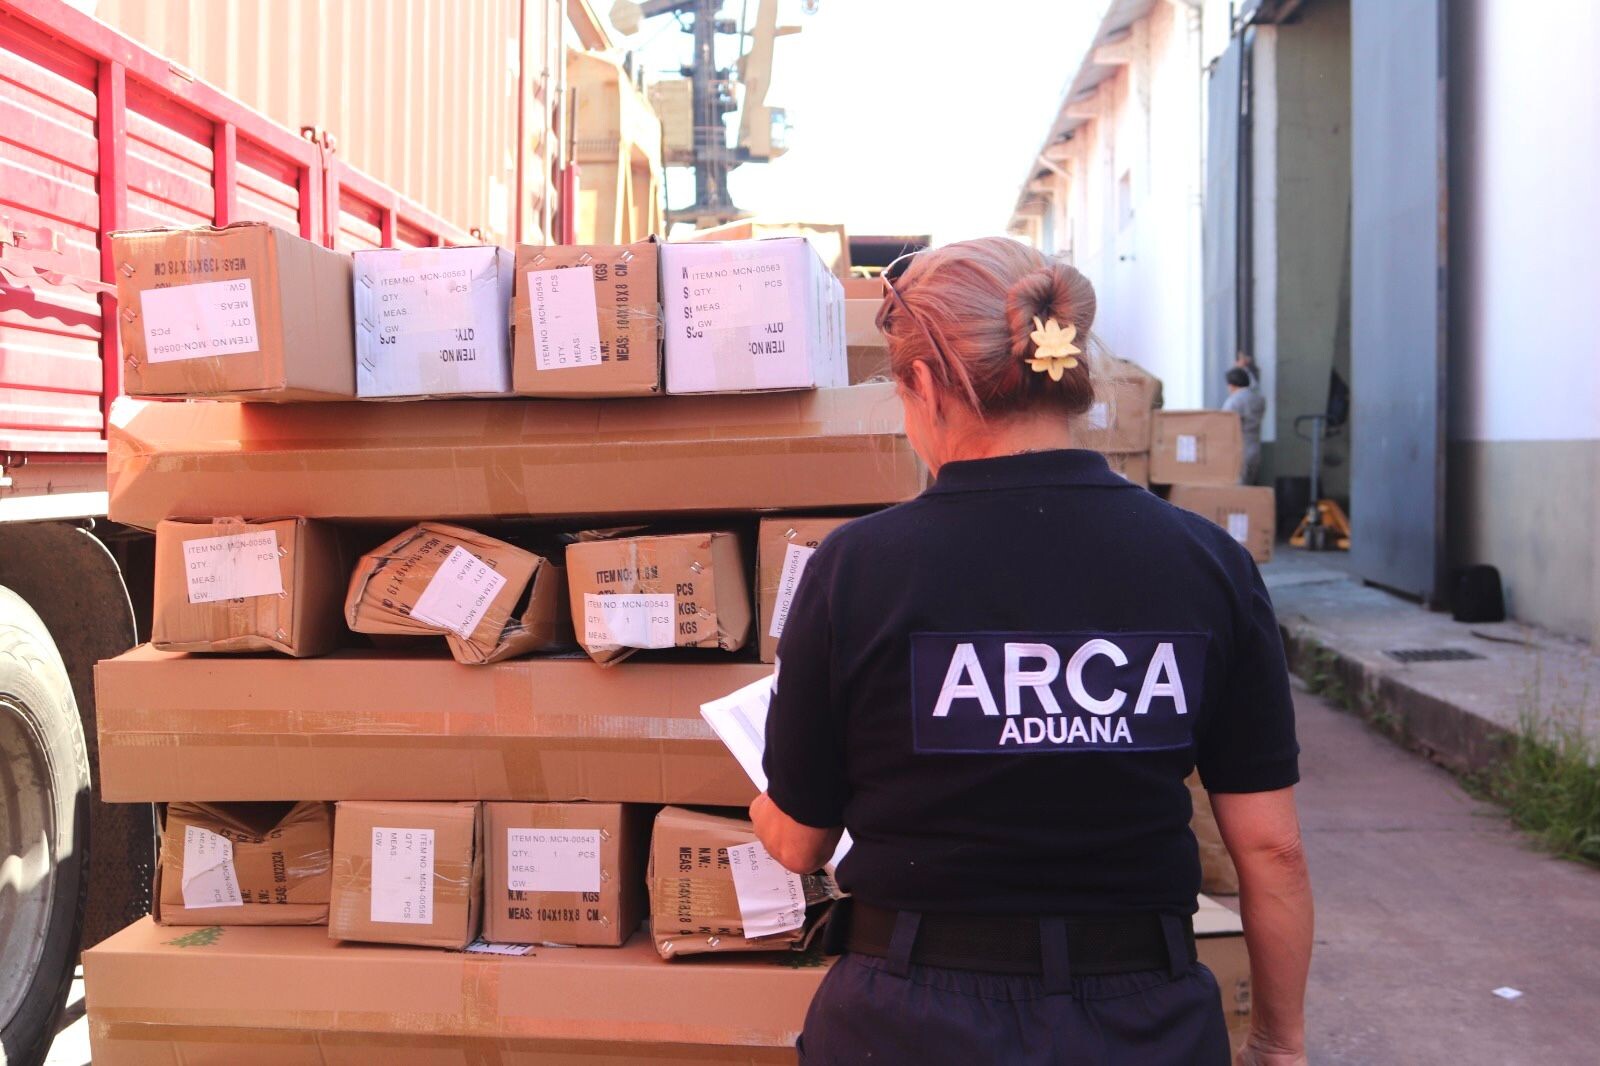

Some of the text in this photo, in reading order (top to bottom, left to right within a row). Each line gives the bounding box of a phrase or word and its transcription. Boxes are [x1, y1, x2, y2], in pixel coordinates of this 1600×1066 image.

[154, 262, 166, 276] CM
[595, 263, 608, 282] KGS
[692, 271, 713, 281] ITEM
[381, 277, 401, 286] ITEM
[551, 274, 559, 293] PCS
[764, 279, 783, 288] PCS
[150, 327, 171, 337] PCS
[195, 323, 200, 331] 1
[455, 327, 475, 341] QTY:
[229, 335, 253, 346] ITEM
[748, 340, 785, 355] ITEM NO:
[439, 348, 476, 362] ITEM NO:
[616, 335, 630, 361] MEAS:
[543, 345, 551, 366] ITEM
[188, 545, 208, 554] ITEM
[257, 553, 274, 561] PCS
[596, 570, 616, 584] ITEM
[617, 568, 633, 582] NO:
[484, 575, 499, 595] ITEM
[676, 583, 694, 596] PCS
[587, 600, 602, 608] ITEM
[678, 602, 696, 615] KGS
[651, 616, 669, 624] PCS
[680, 621, 698, 635] KGS
[932, 638, 1188, 717] ARCA
[999, 716, 1133, 745] ADUANA
[420, 833, 428, 854] ITEM
[511, 835, 532, 843] ITEM
[679, 846, 692, 873] MEAS:
[698, 847, 711, 869] N.W.:
[717, 847, 730, 869] G.W.:
[508, 889, 600, 902] N.W.: KGS
[403, 901, 411, 919] PCS
[508, 907, 533, 920] MEAS:
[537, 908, 580, 921] 104X18X8
